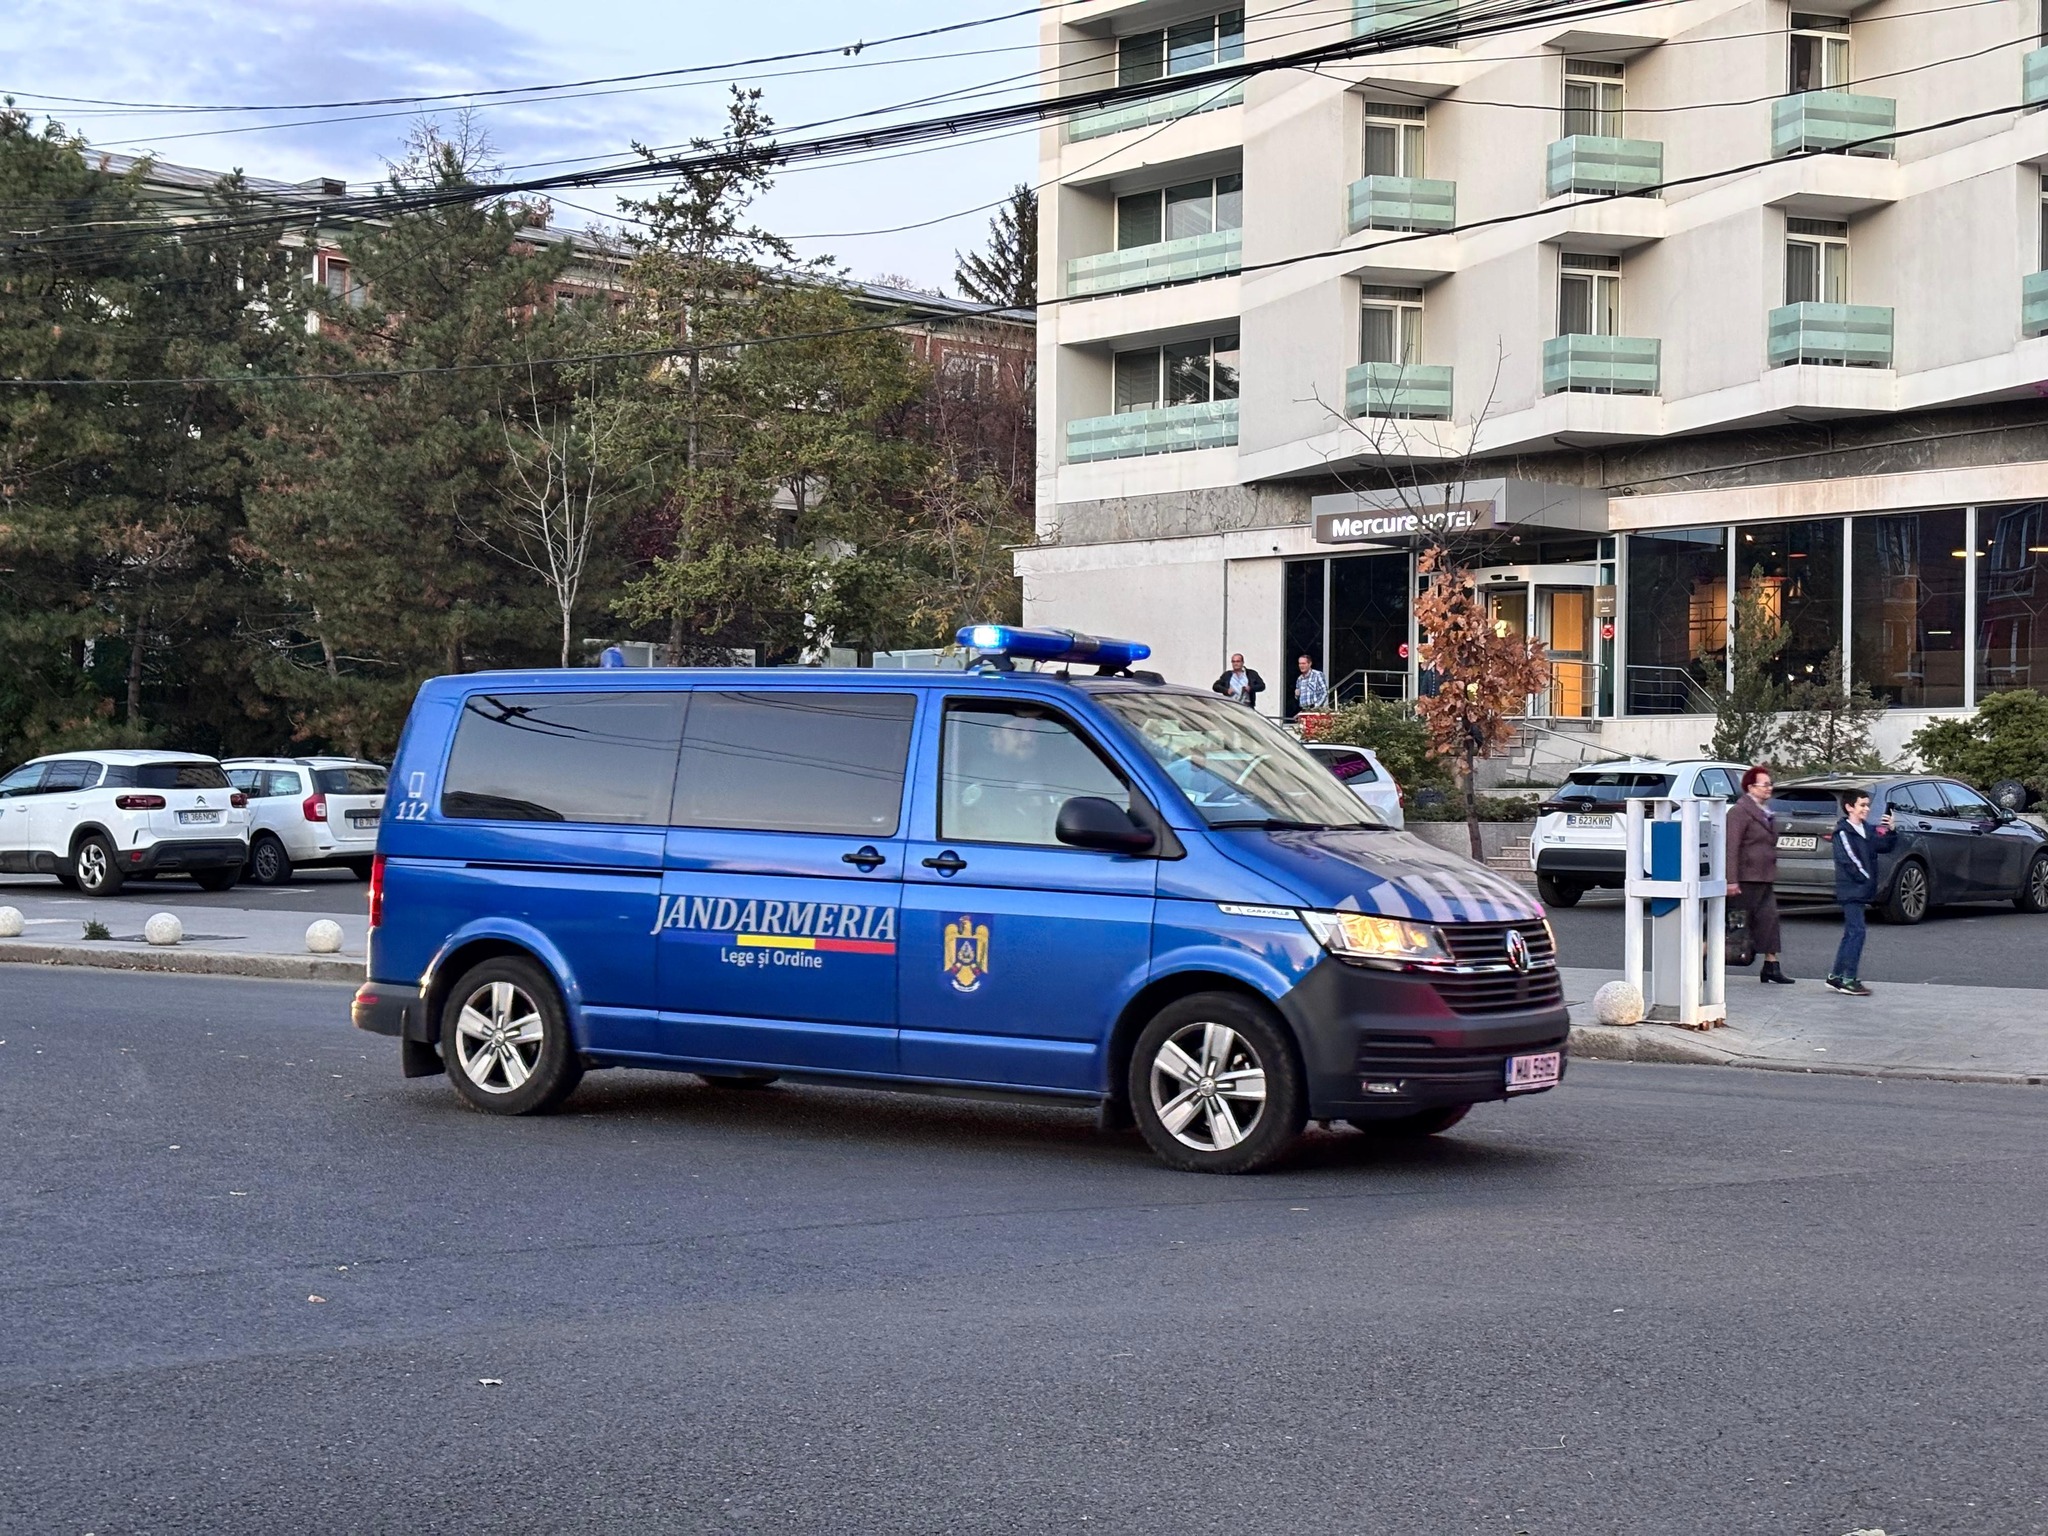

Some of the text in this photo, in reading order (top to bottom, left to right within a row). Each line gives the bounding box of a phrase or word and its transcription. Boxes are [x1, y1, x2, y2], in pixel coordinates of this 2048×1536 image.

[1332, 514, 1418, 537] Mercure
[395, 801, 429, 820] 112
[650, 895, 897, 940] JANDARMERIA
[721, 947, 823, 968] Lege și Ordine
